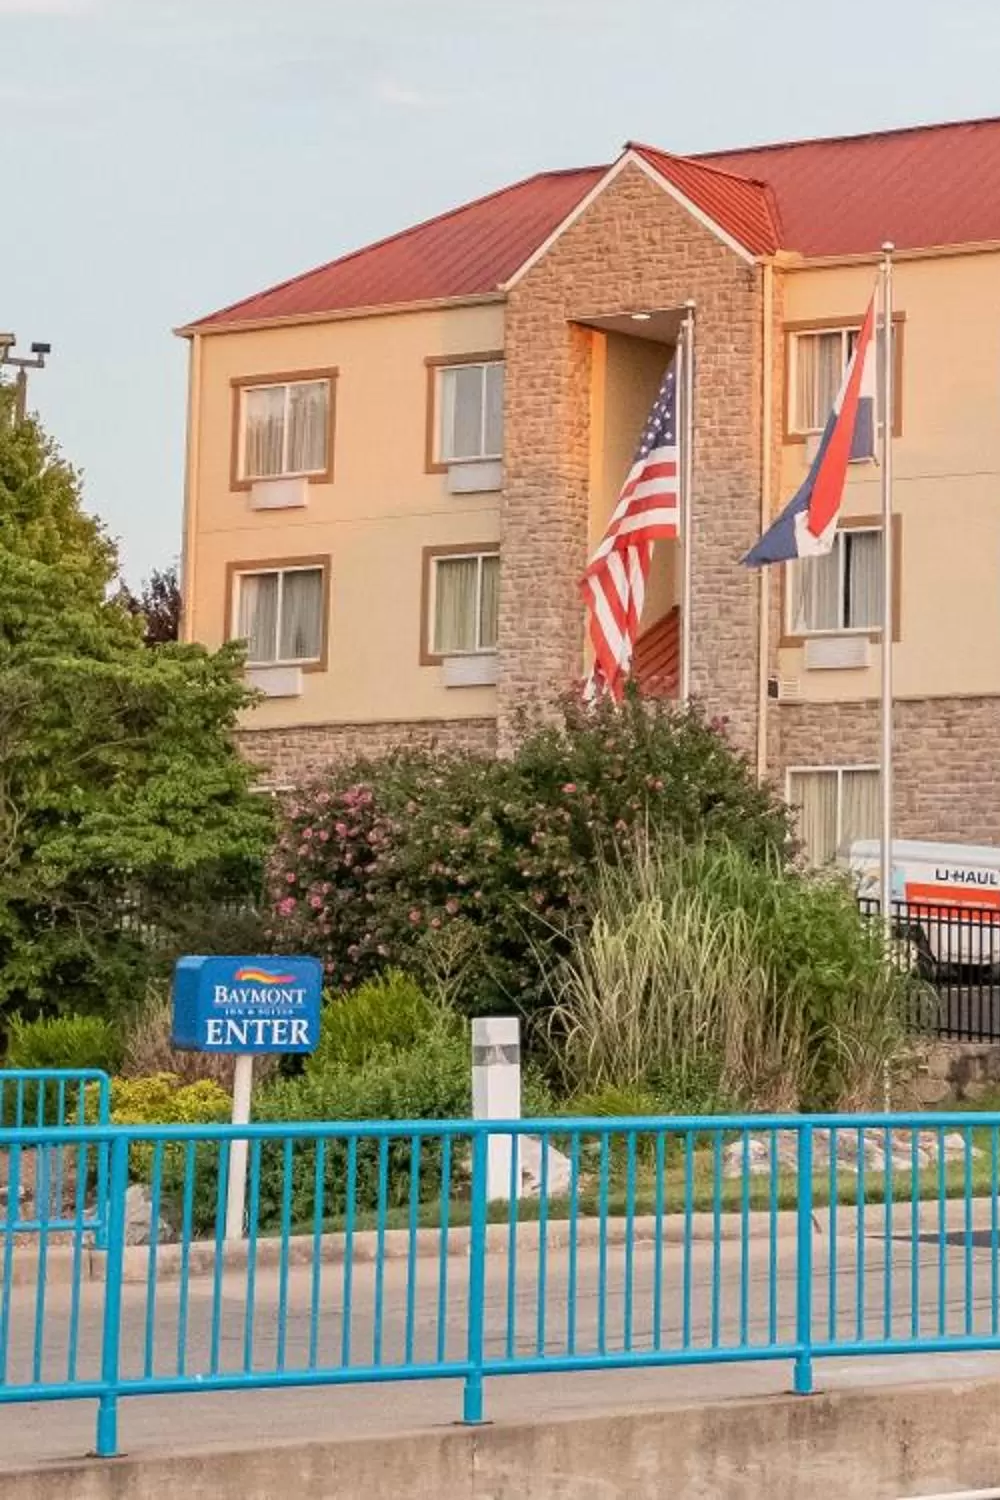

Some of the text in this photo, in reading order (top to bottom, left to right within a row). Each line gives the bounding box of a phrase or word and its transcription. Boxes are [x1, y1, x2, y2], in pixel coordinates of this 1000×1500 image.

[935, 868, 998, 885] U-HAUL
[215, 985, 306, 1004] BAYMONT
[205, 1019, 311, 1045] ENTER
